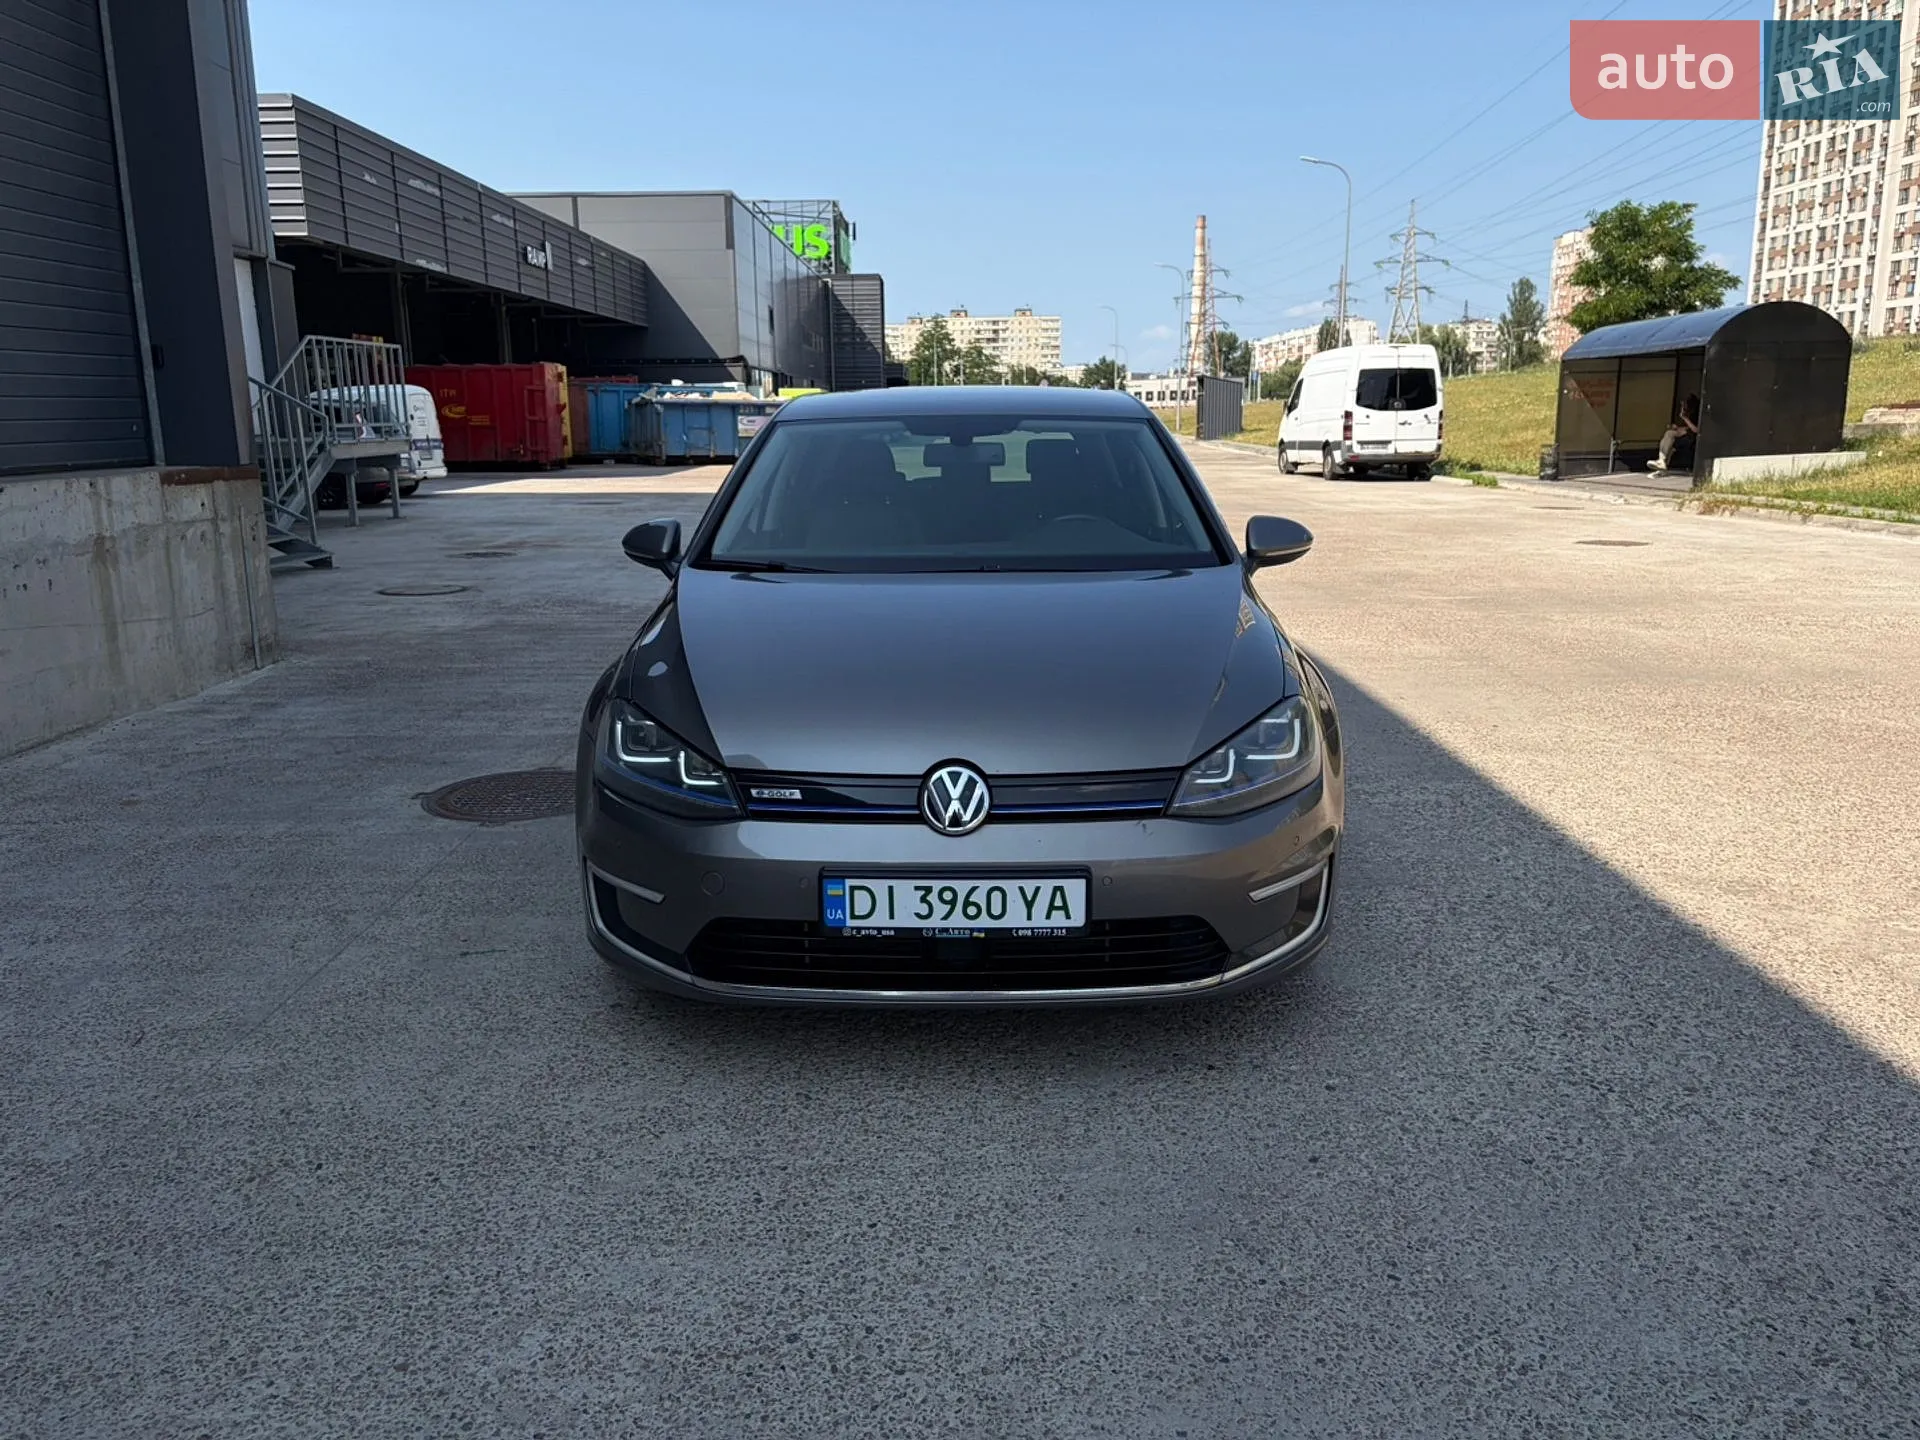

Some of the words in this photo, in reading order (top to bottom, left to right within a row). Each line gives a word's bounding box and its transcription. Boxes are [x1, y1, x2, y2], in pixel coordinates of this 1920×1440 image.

[826, 908, 844, 920] UA
[848, 885, 895, 921] DI
[913, 885, 1007, 921] 3960
[1017, 885, 1072, 921] YA
